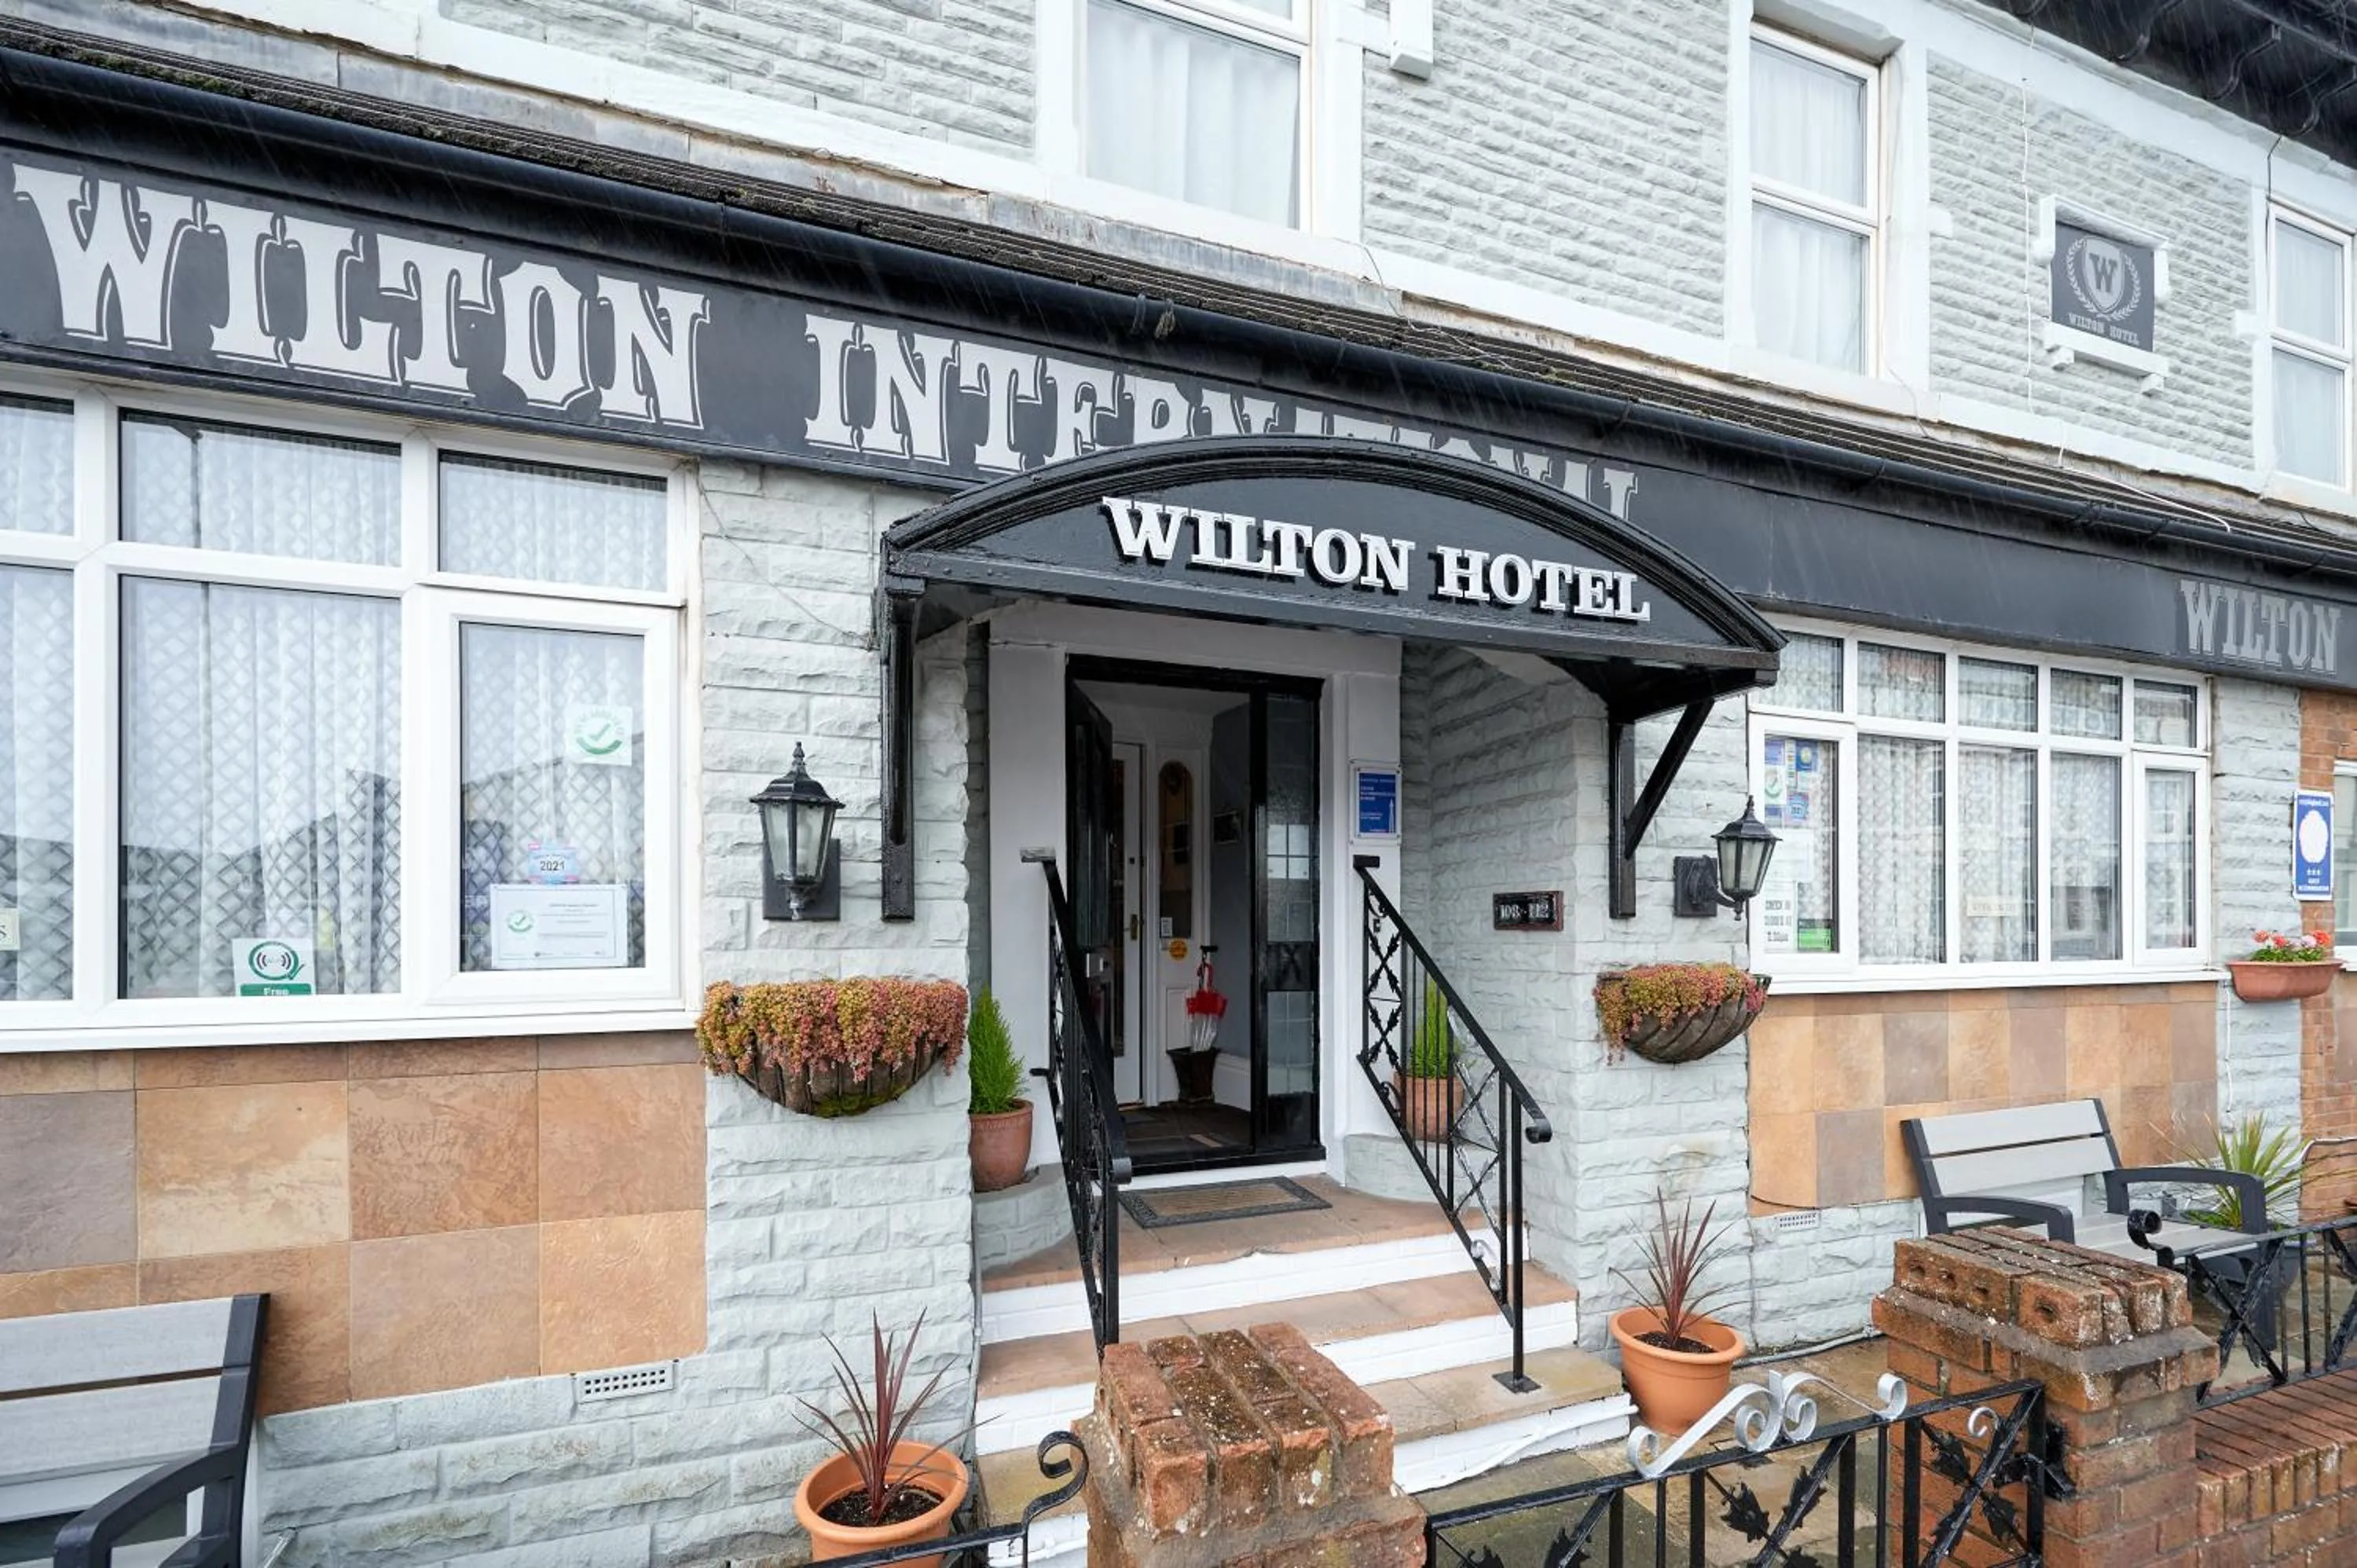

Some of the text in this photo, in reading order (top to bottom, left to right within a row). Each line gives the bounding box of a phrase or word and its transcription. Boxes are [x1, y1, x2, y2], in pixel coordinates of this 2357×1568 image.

[13, 164, 711, 430] WILTON
[2088, 253, 2118, 293] W
[2068, 313, 2105, 334] WILTON
[1102, 496, 1651, 621] WILTON HOTEL
[2180, 580, 2341, 675] WILTON
[540, 860, 565, 871] 2021
